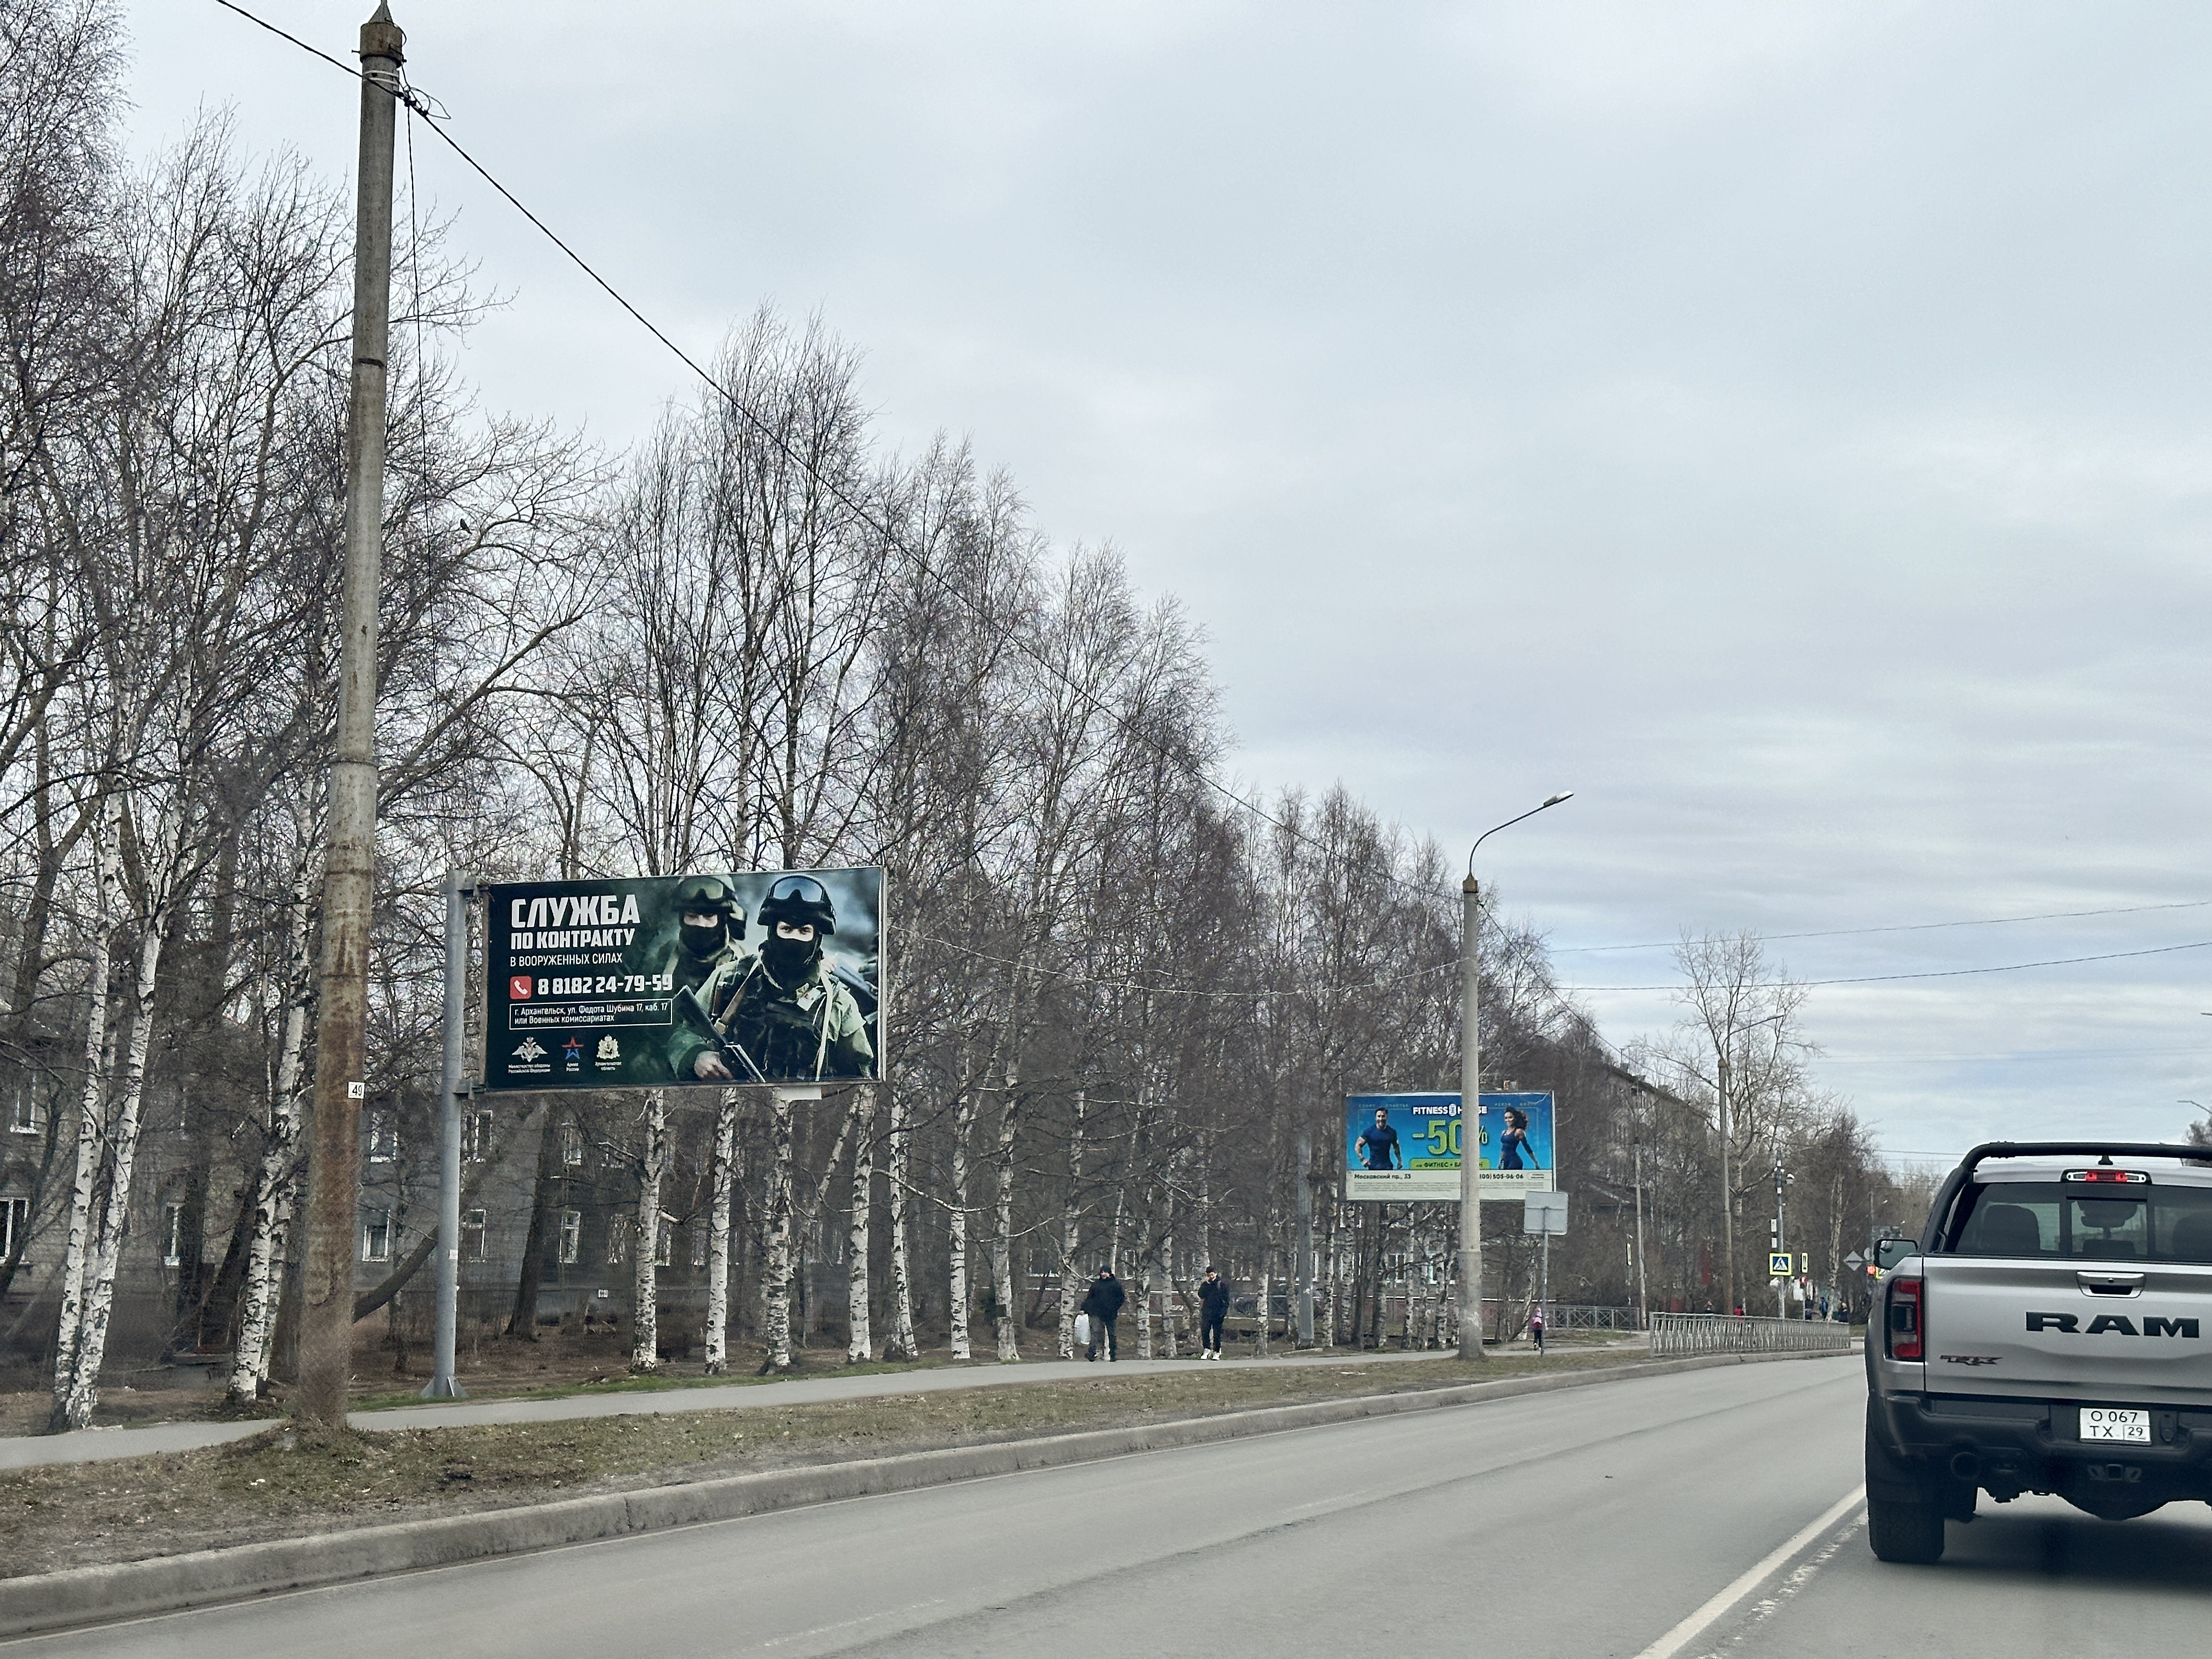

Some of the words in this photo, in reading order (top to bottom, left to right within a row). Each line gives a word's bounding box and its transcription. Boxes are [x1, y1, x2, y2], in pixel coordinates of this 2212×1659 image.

[511, 894, 641, 928] СЛУЖБА
[511, 932, 533, 950] ПО
[537, 928, 635, 949] КОНТРАКТУ
[510, 956, 516, 967] В
[519, 953, 590, 967] ВООРУЖЕННЫХ
[592, 952, 623, 964] СИЛАХ
[538, 978, 549, 995] 8
[552, 977, 592, 994] 8182
[596, 974, 673, 993] 24-79-59
[521, 1007, 566, 1017] Архангельск,
[567, 1007, 577, 1015] ул.
[579, 1005, 605, 1014] Федота
[606, 1004, 634, 1014] Шубина
[645, 1002, 659, 1012] каб.
[661, 1002, 668, 1011] 17
[529, 1015, 560, 1024] Военных
[561, 1014, 614, 1023] комиссариатах
[352, 1085, 362, 1096] 49
[1413, 1106, 1448, 1115] FITNESS
[1457, 1106, 1487, 1114] HSE
[2026, 1311, 2199, 1339] RAM
[2108, 1411, 2137, 1423] 067
[2128, 1426, 2143, 1436] 29
